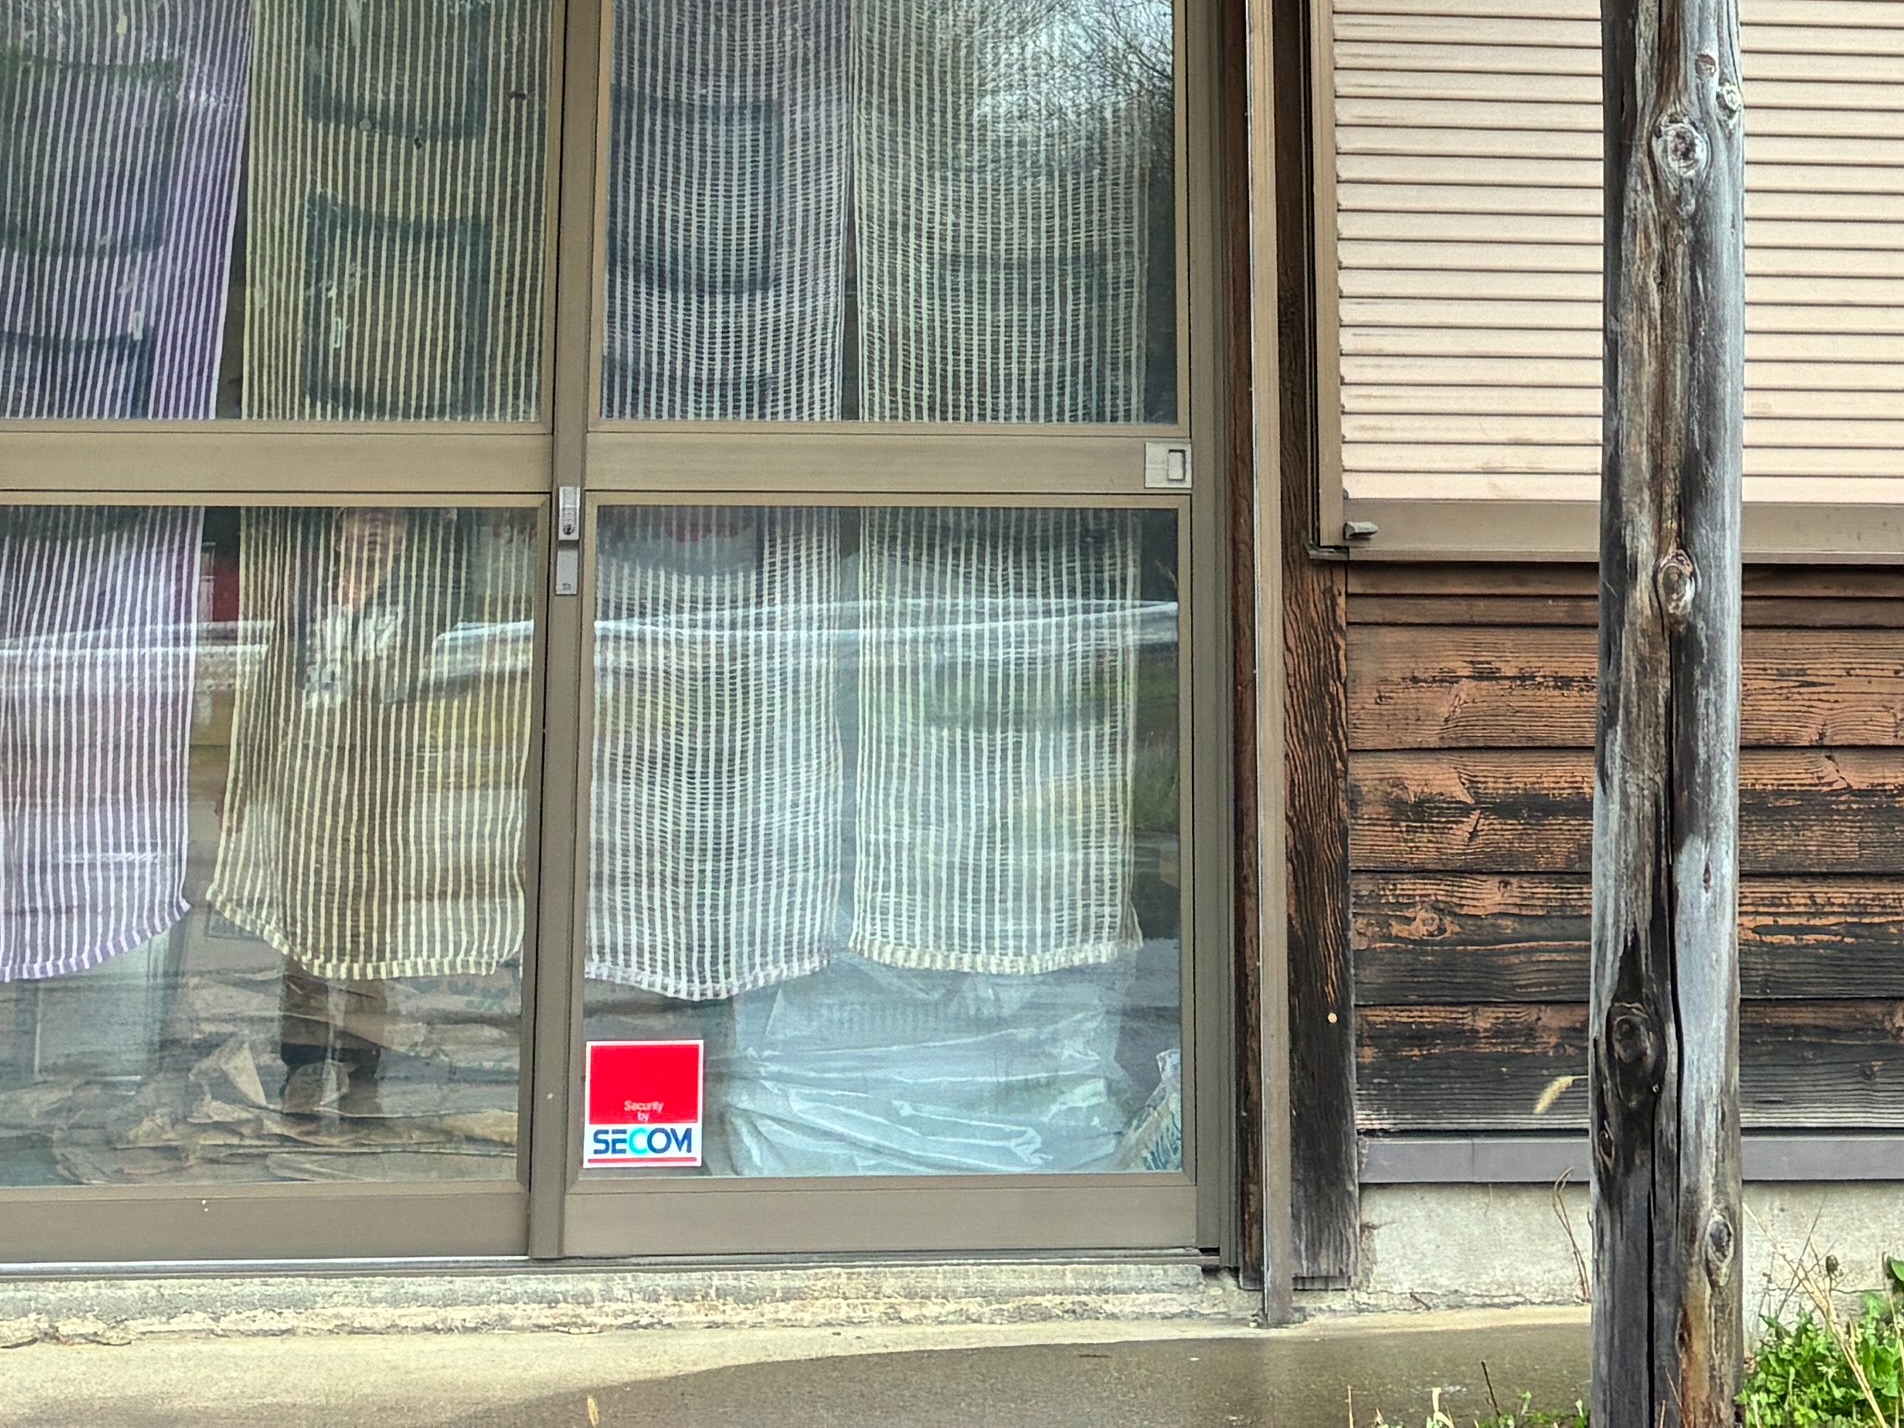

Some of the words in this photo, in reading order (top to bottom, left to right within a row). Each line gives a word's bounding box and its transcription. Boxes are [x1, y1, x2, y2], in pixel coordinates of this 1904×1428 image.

[624, 1100, 664, 1113] Security
[637, 1111, 650, 1123] by
[593, 1128, 693, 1155] SECOM
